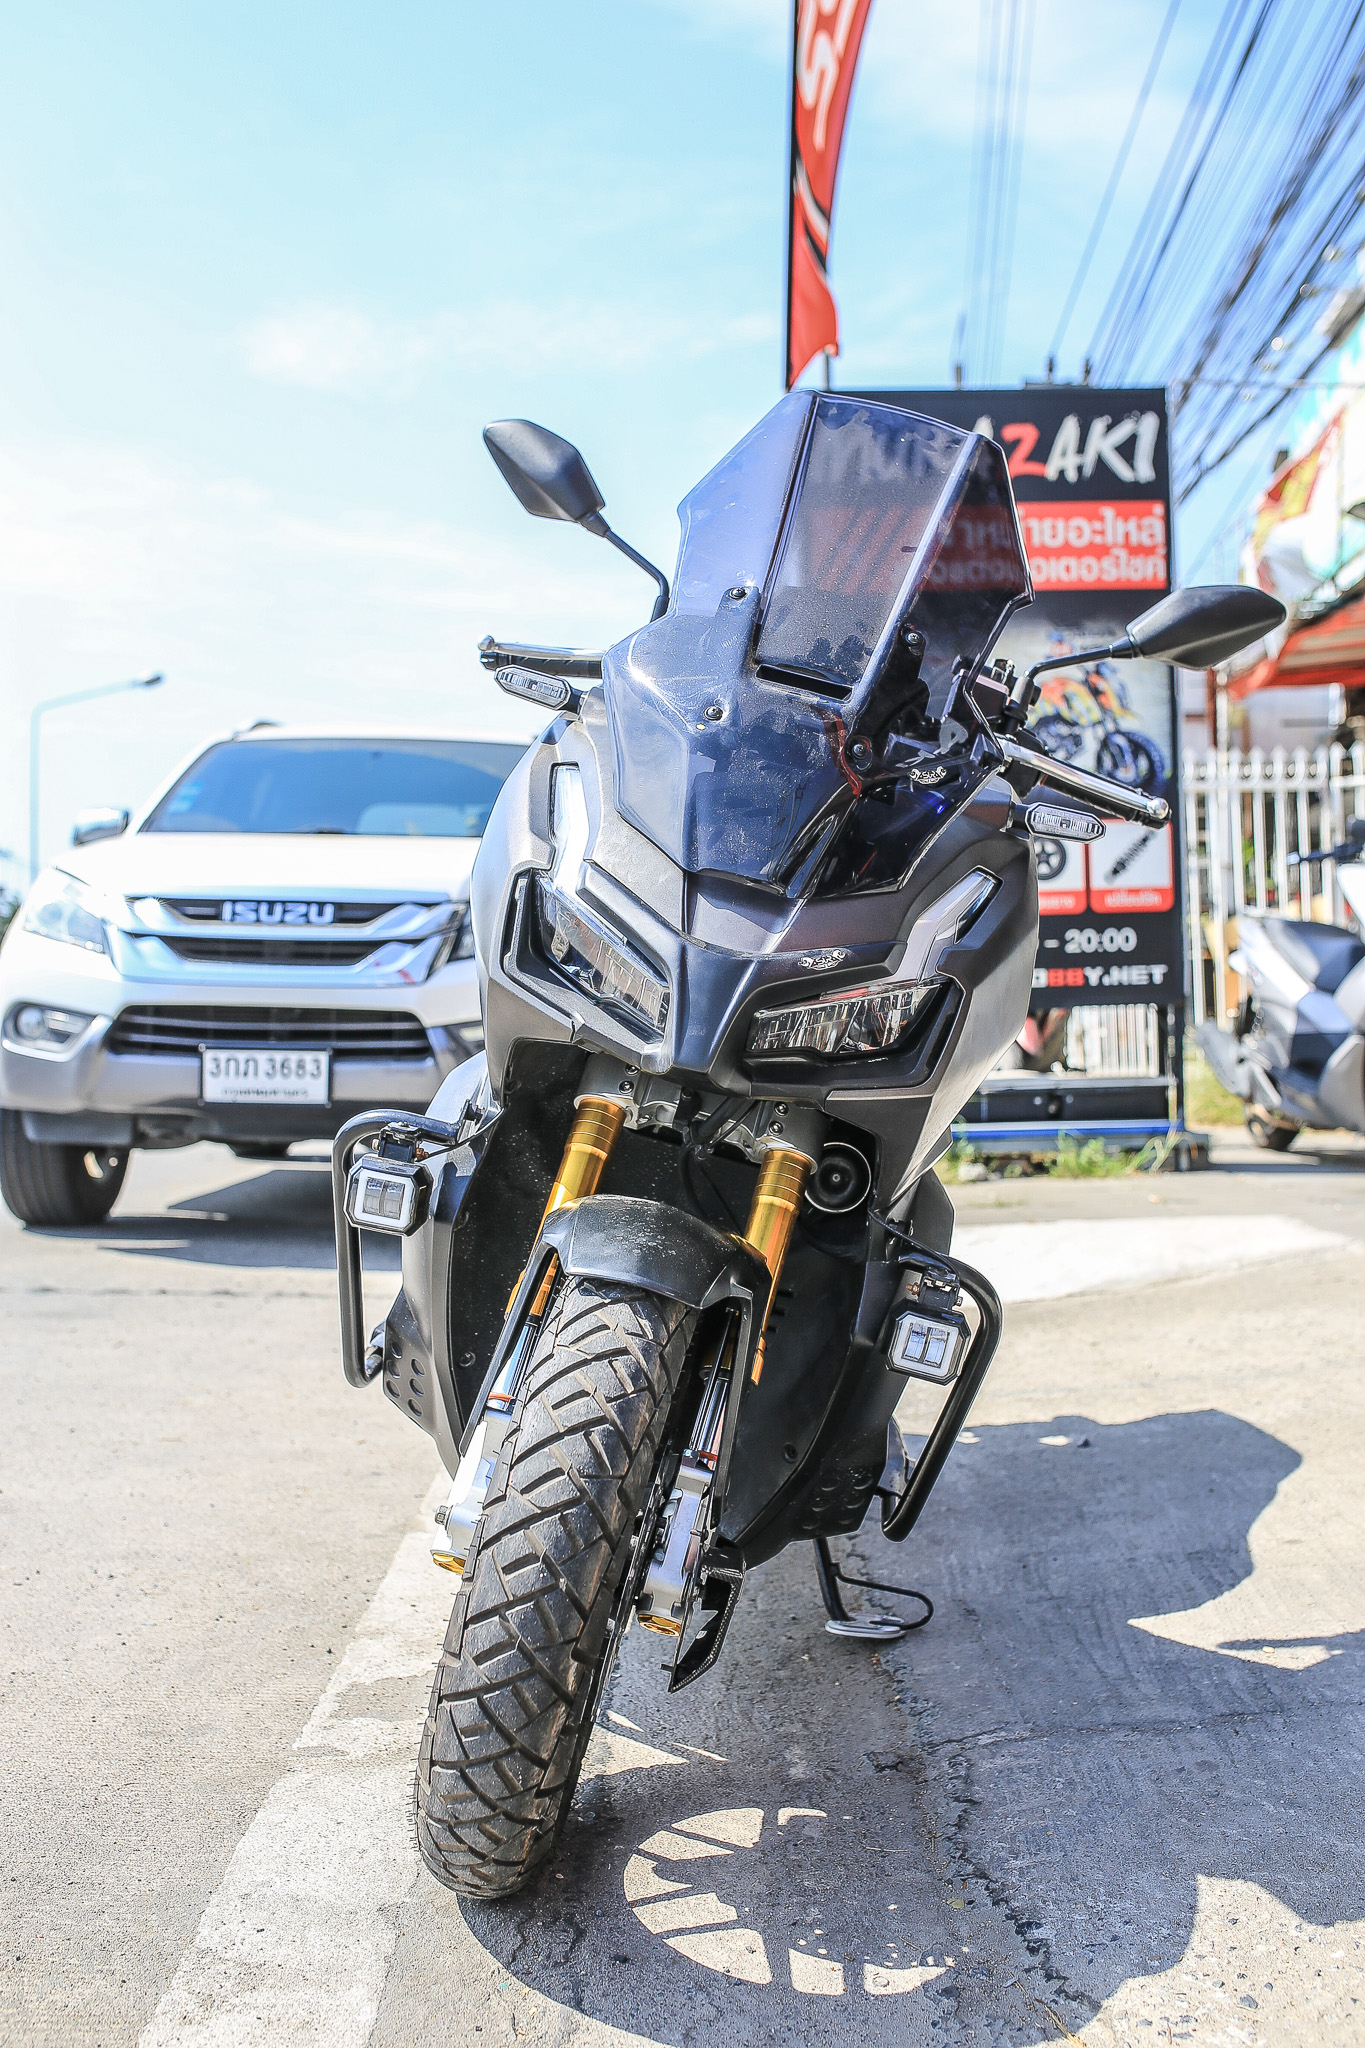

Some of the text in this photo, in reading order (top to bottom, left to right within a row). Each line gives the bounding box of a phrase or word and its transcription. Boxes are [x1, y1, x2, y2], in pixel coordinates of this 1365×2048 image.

[222, 900, 335, 924] ISUZU
[1064, 926, 1138, 954] 20:00
[264, 1056, 322, 1080] 3683
